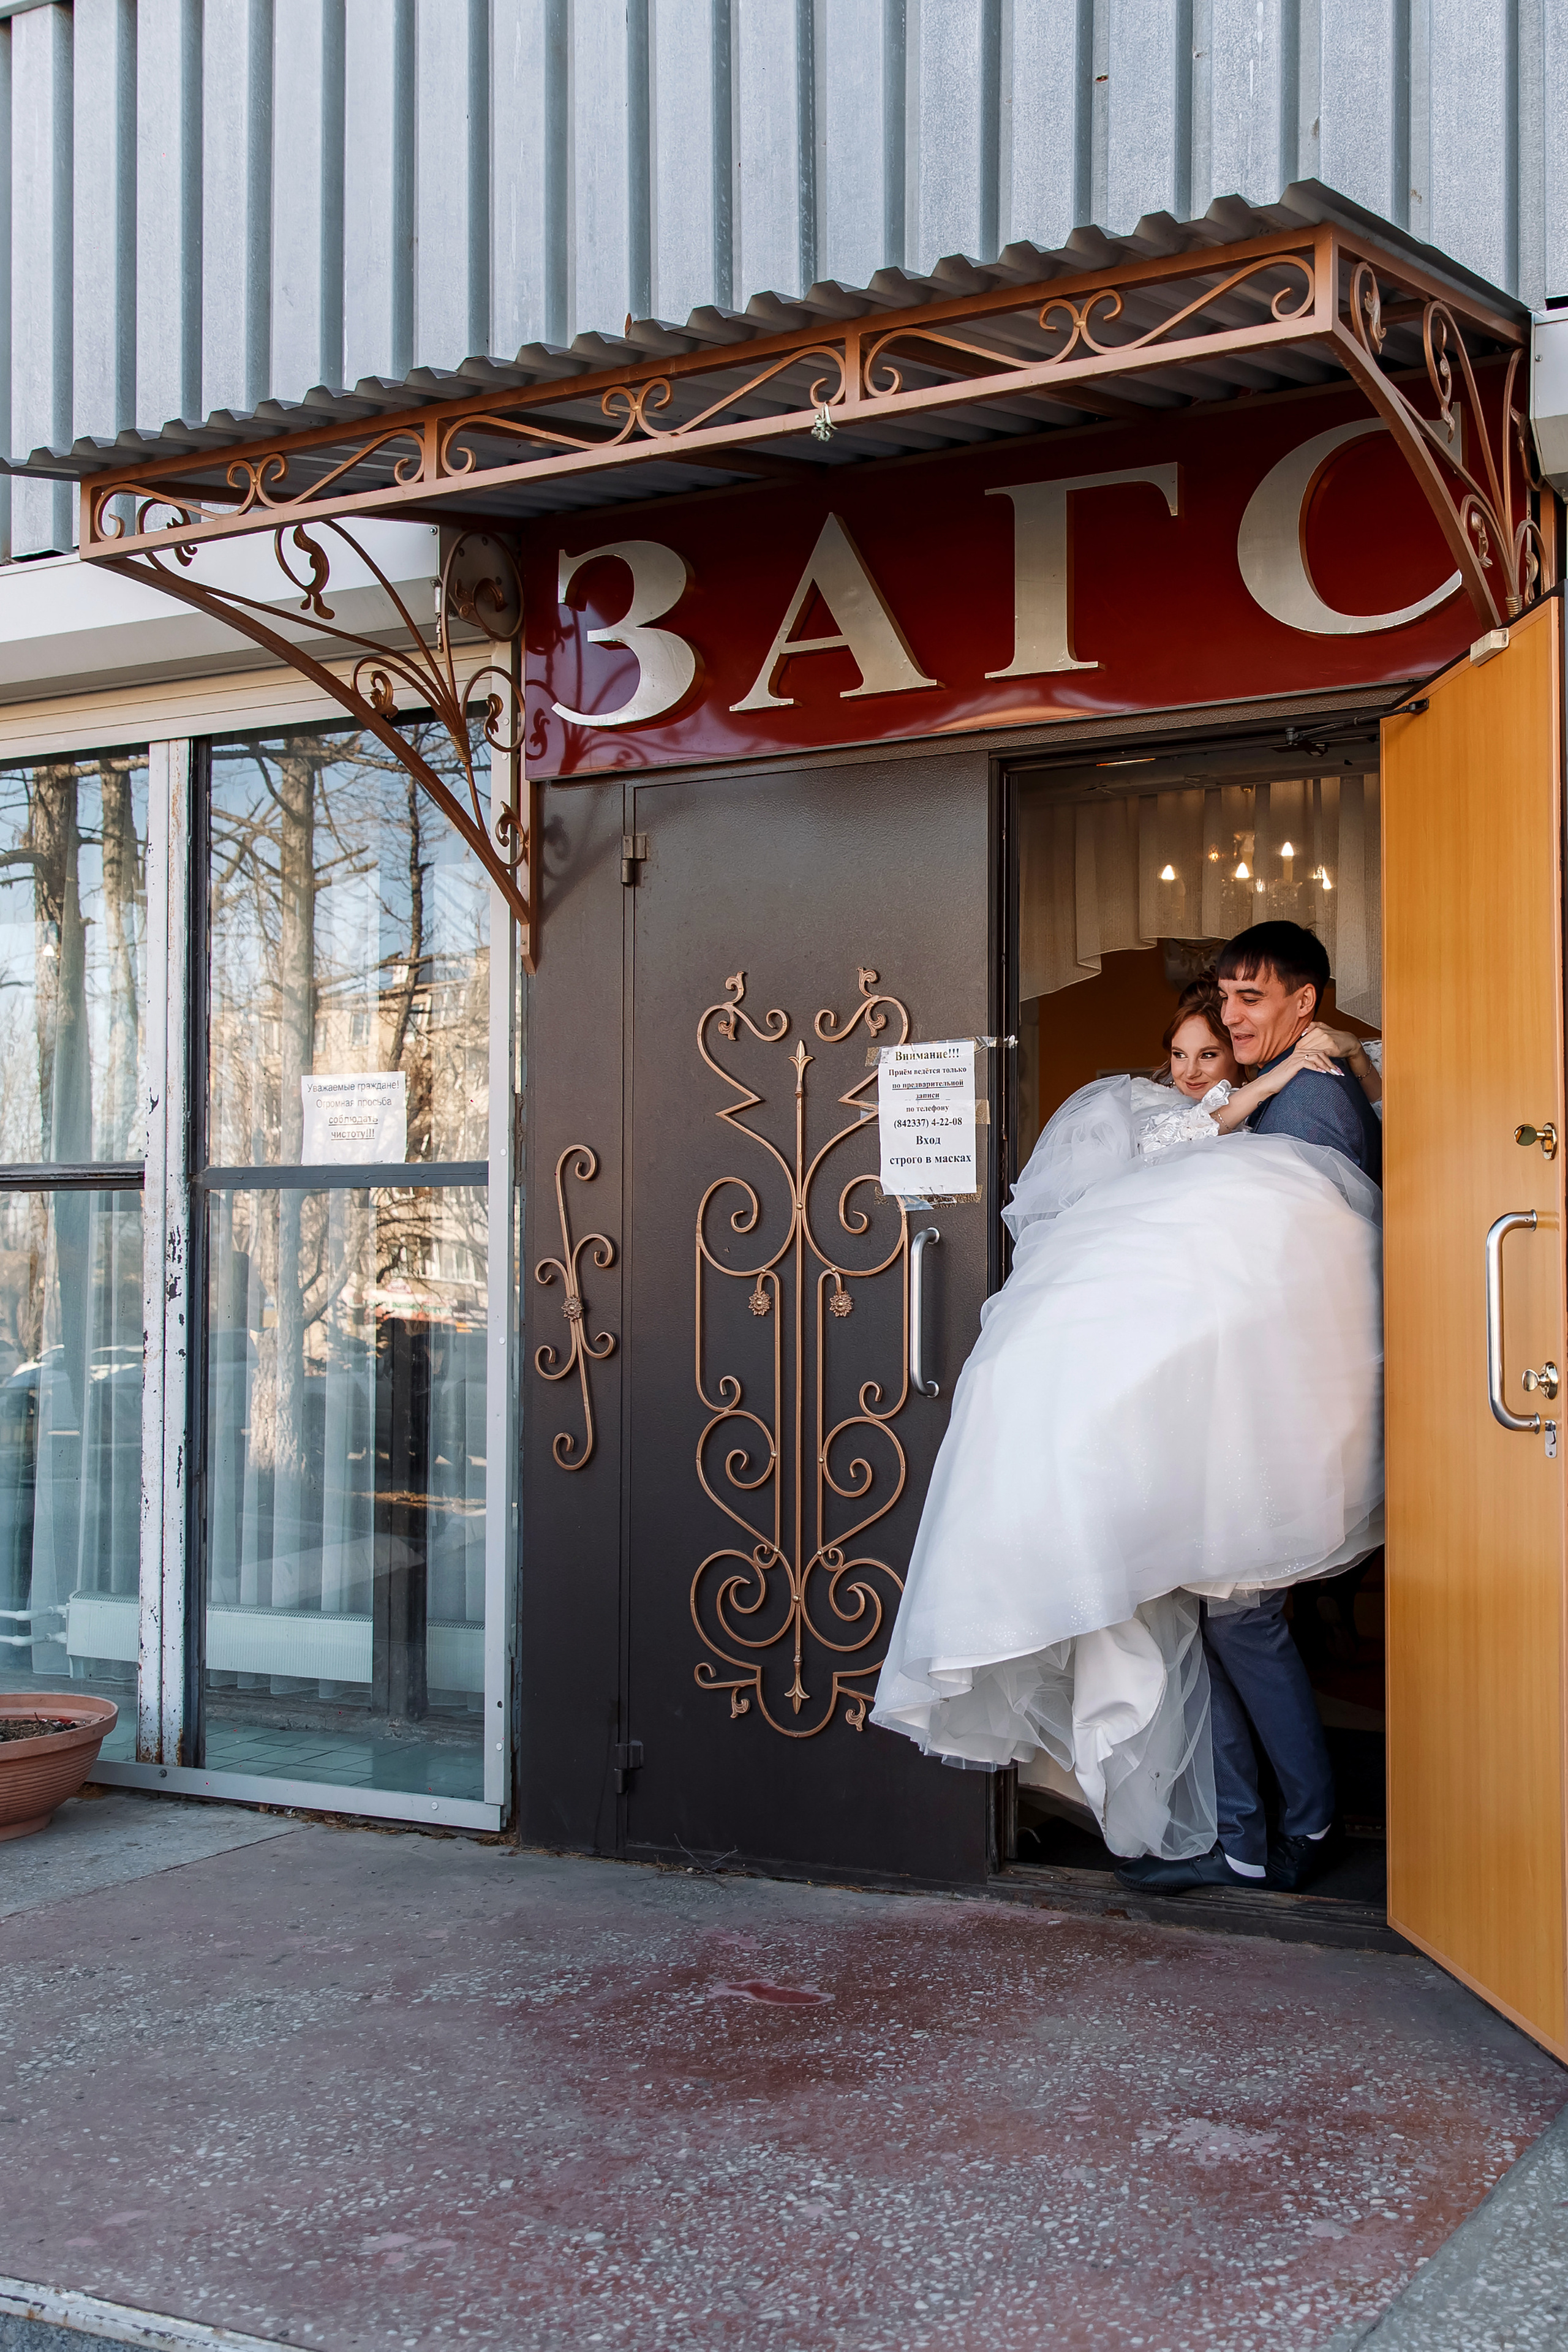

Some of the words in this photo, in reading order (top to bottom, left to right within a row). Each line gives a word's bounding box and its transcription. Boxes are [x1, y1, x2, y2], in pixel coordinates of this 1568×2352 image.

[551, 402, 1465, 728] ЗАГС
[895, 1048, 960, 1061] Внимание!!!
[888, 1068, 913, 1077] Приём
[307, 1083, 355, 1093] Уважаемые
[357, 1080, 399, 1091] граждане!
[902, 1079, 964, 1090] предварительной
[316, 1099, 355, 1110] Огромная
[357, 1097, 392, 1108] просьба
[916, 1104, 949, 1113] телефону
[328, 1115, 379, 1125] соблюдать
[894, 1119, 929, 1129] (842337)
[931, 1117, 963, 1126] 4-22-08
[331, 1128, 375, 1139] чистоту!!!
[916, 1135, 941, 1146] Вход
[889, 1156, 923, 1167] строго
[935, 1154, 972, 1163] масках
